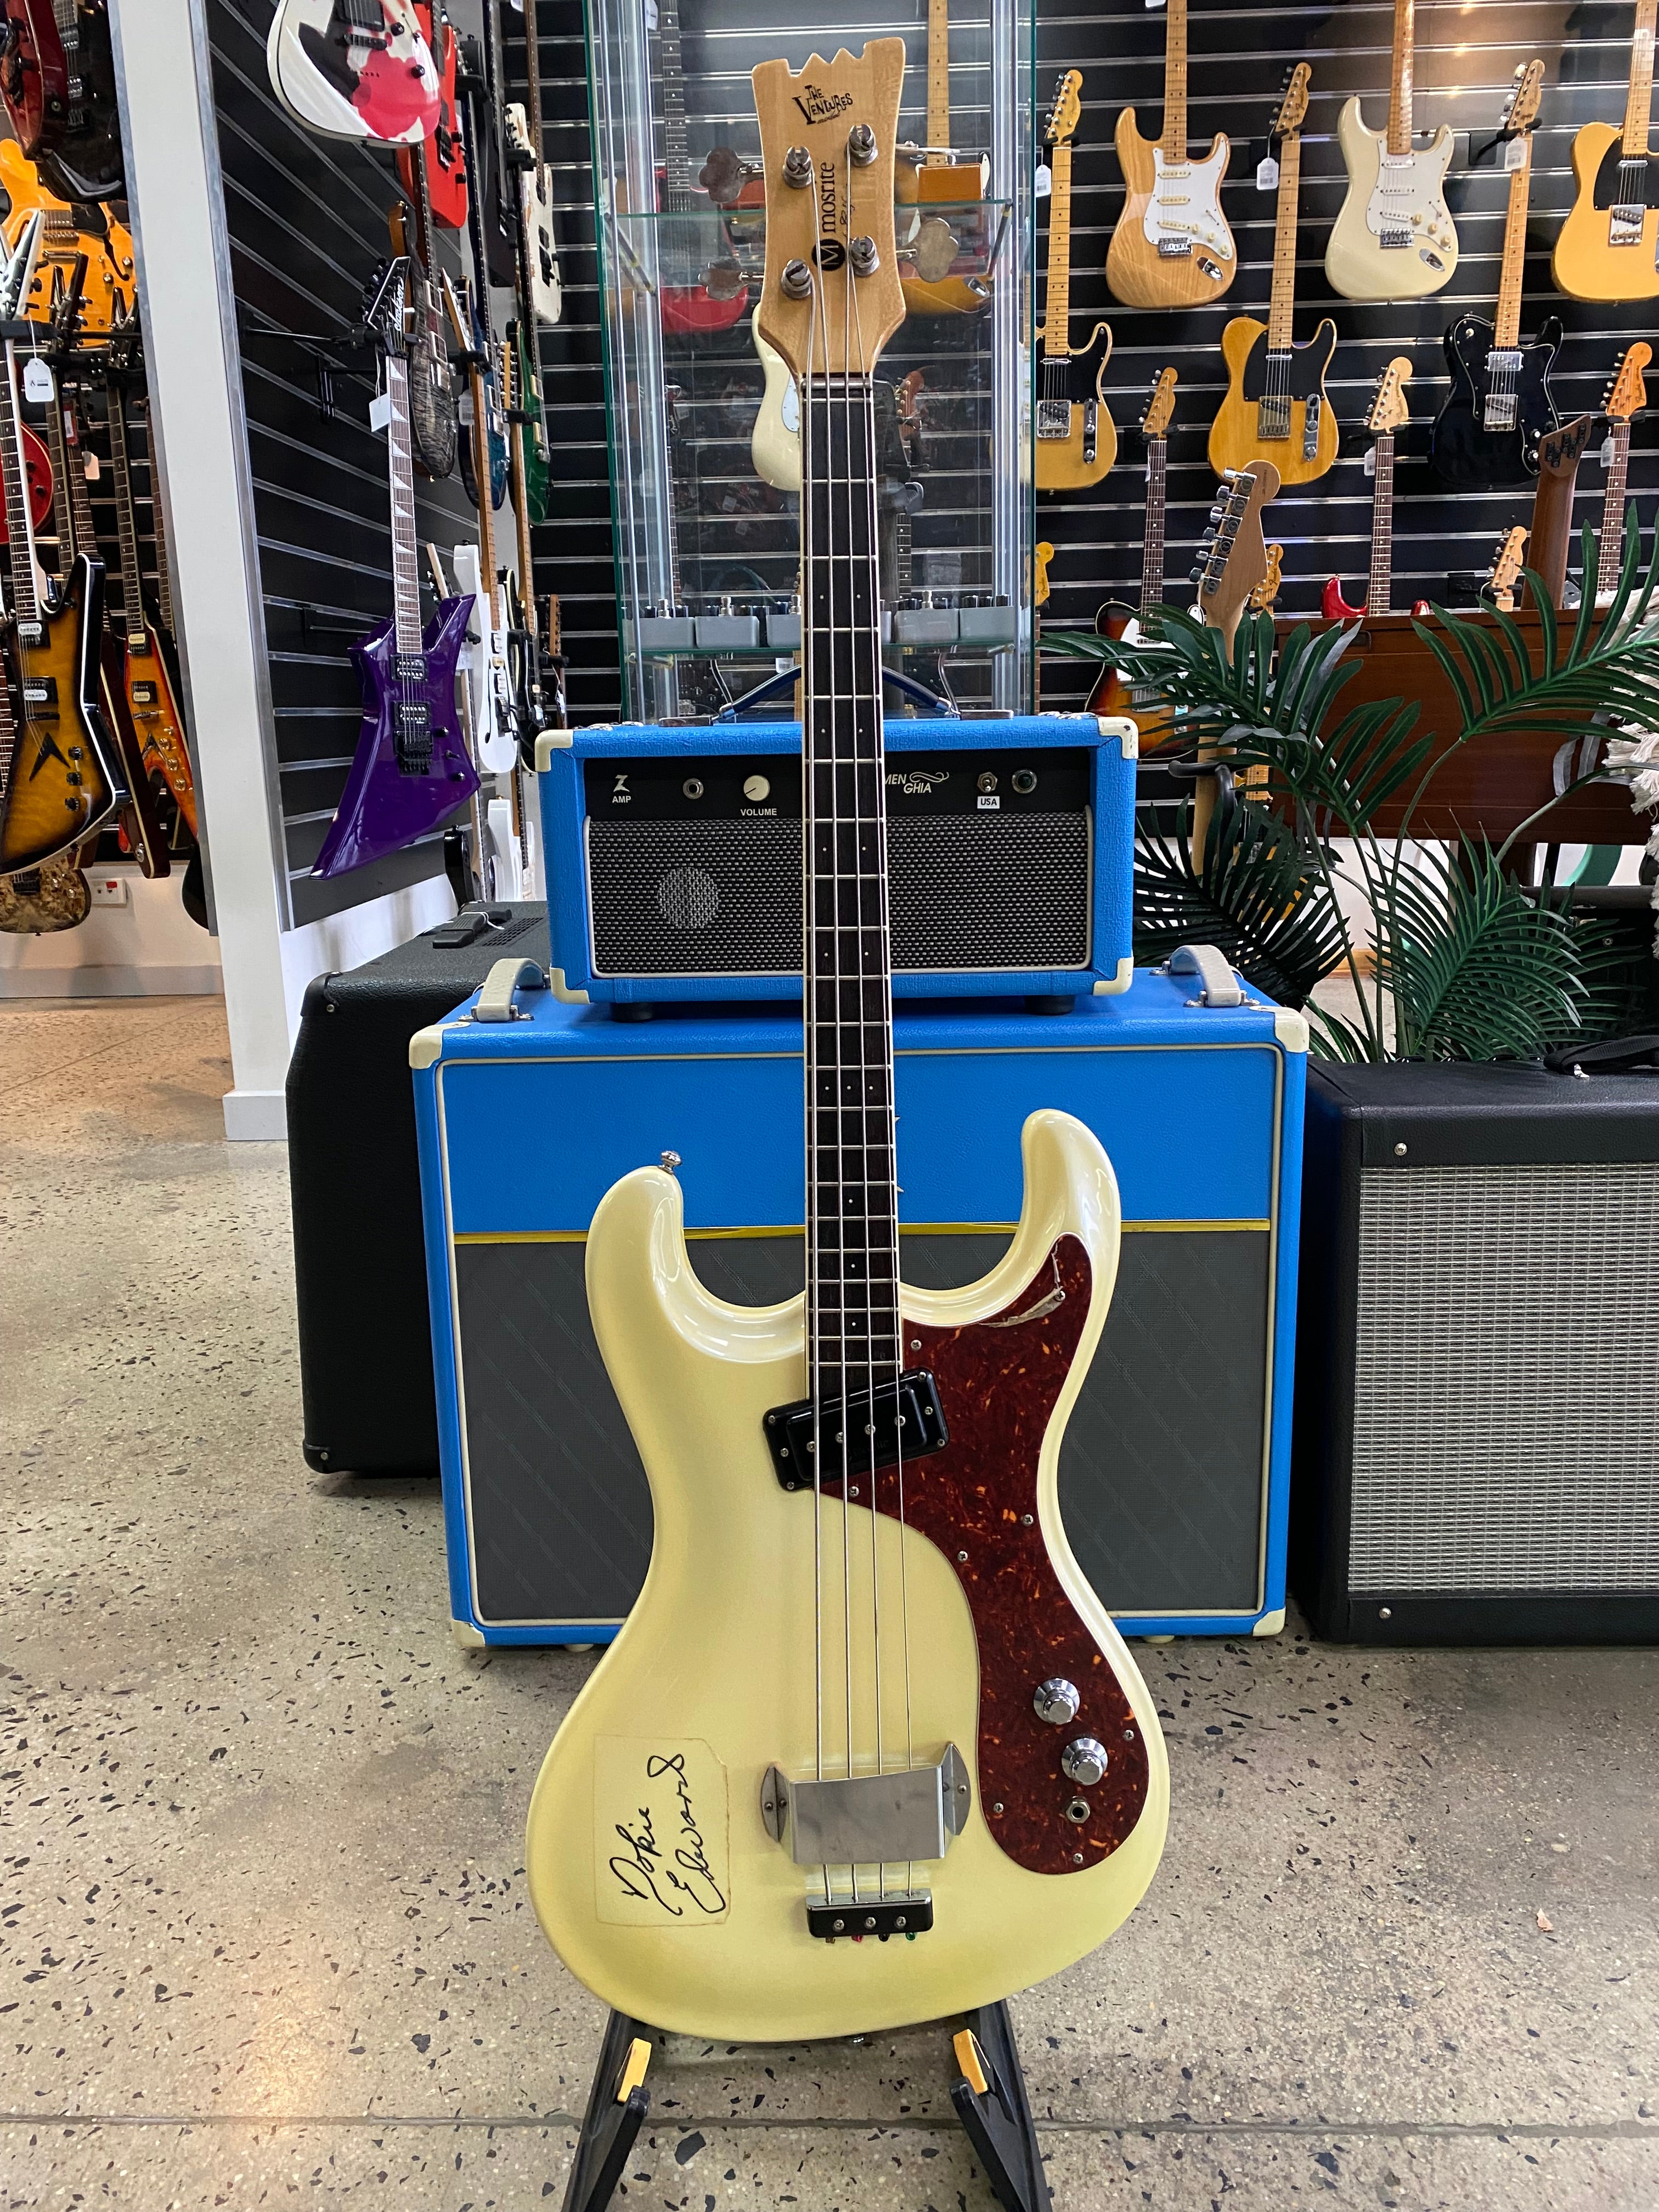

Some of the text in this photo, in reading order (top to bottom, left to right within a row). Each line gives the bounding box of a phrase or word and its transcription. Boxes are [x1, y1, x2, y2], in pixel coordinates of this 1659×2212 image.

[804, 84, 825, 100] THE
[791, 93, 854, 126] VENTURES
[820, 162, 836, 233] mosrite
[903, 783, 932, 794] GHIA
